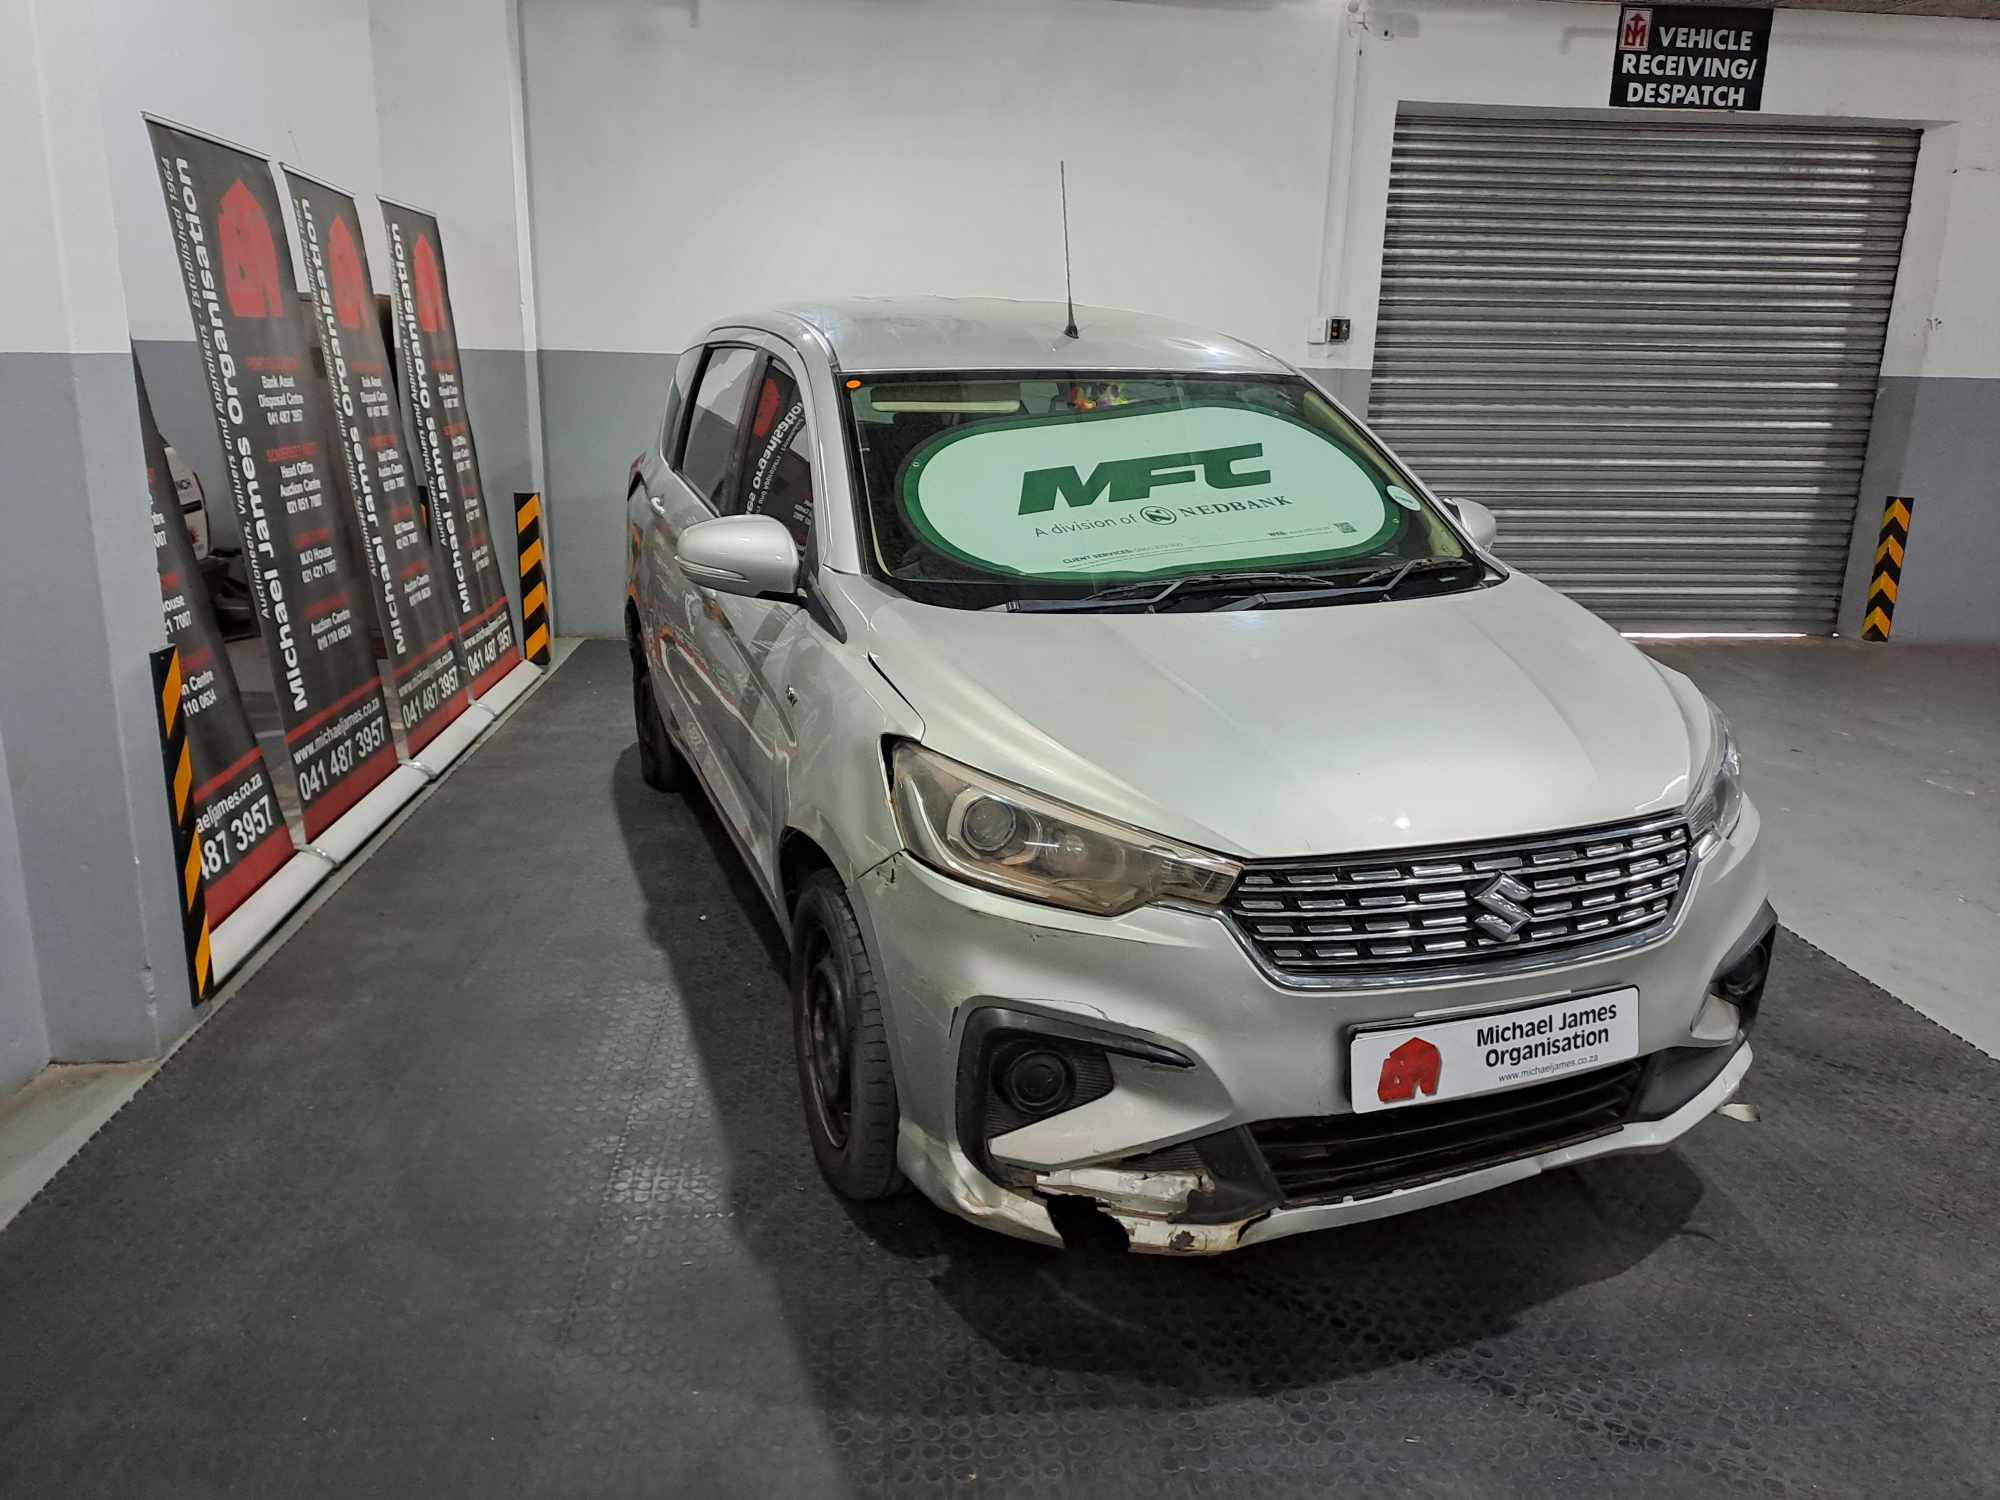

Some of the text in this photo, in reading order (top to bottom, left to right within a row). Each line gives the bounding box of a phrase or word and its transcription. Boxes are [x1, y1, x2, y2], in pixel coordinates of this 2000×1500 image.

[1621, 53, 1760, 80] RECEIVING/
[1658, 26, 1753, 51] VEHICLE
[1626, 82, 1745, 107] DESPATCH
[161, 156, 178, 201] 1964
[171, 206, 202, 309] Established
[301, 198, 353, 417] Organisation
[391, 223, 431, 409] Organisation
[175, 157, 308, 712] Michael James Organisation
[218, 417, 233, 450] and
[426, 416, 450, 503] James
[228, 455, 247, 514] Valuers
[350, 426, 379, 527] James
[1018, 442, 1271, 516] MFC
[1034, 527, 1048, 538] A
[1051, 516, 1117, 536] division
[1120, 514, 1138, 526] of
[1177, 495, 1294, 519] NEDBANK
[442, 511, 472, 613] Michael
[371, 536, 407, 655] Michael
[467, 648, 485, 677] 041
[484, 638, 498, 664] 487
[402, 665, 459, 729] 041 487 3957
[293, 697, 381, 765] www.michaeljames.co.za
[299, 715, 385, 801] 041 487 3957
[230, 793, 273, 852] 3957
[1476, 1004, 1617, 1047] Michael James
[1485, 1026, 1610, 1068] Organisation
[1498, 1053, 1599, 1083] www.michaeljames.co.za
